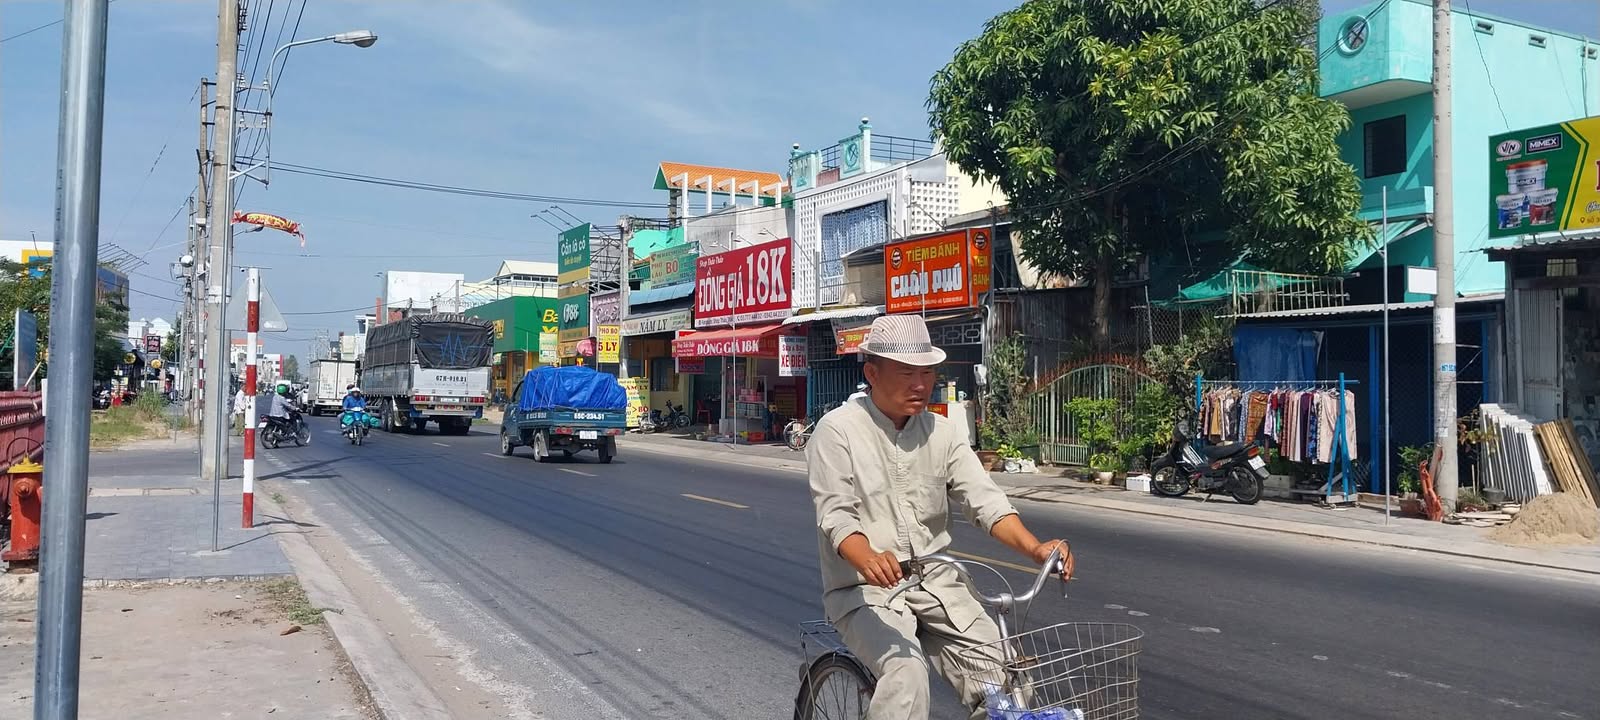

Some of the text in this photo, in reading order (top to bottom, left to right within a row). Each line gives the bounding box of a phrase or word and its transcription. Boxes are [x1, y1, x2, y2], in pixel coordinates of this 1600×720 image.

[1529, 138, 1557, 149] MIMEX
[930, 242, 960, 259] BÁNH
[699, 247, 787, 313] ĐỒNG GIÁ 18K
[891, 262, 963, 299] CHÂU PHÚ
[658, 319, 668, 331] LY
[606, 342, 618, 351] LY
[697, 340, 723, 355] ĐỒNG
[781, 354, 790, 368] XE
